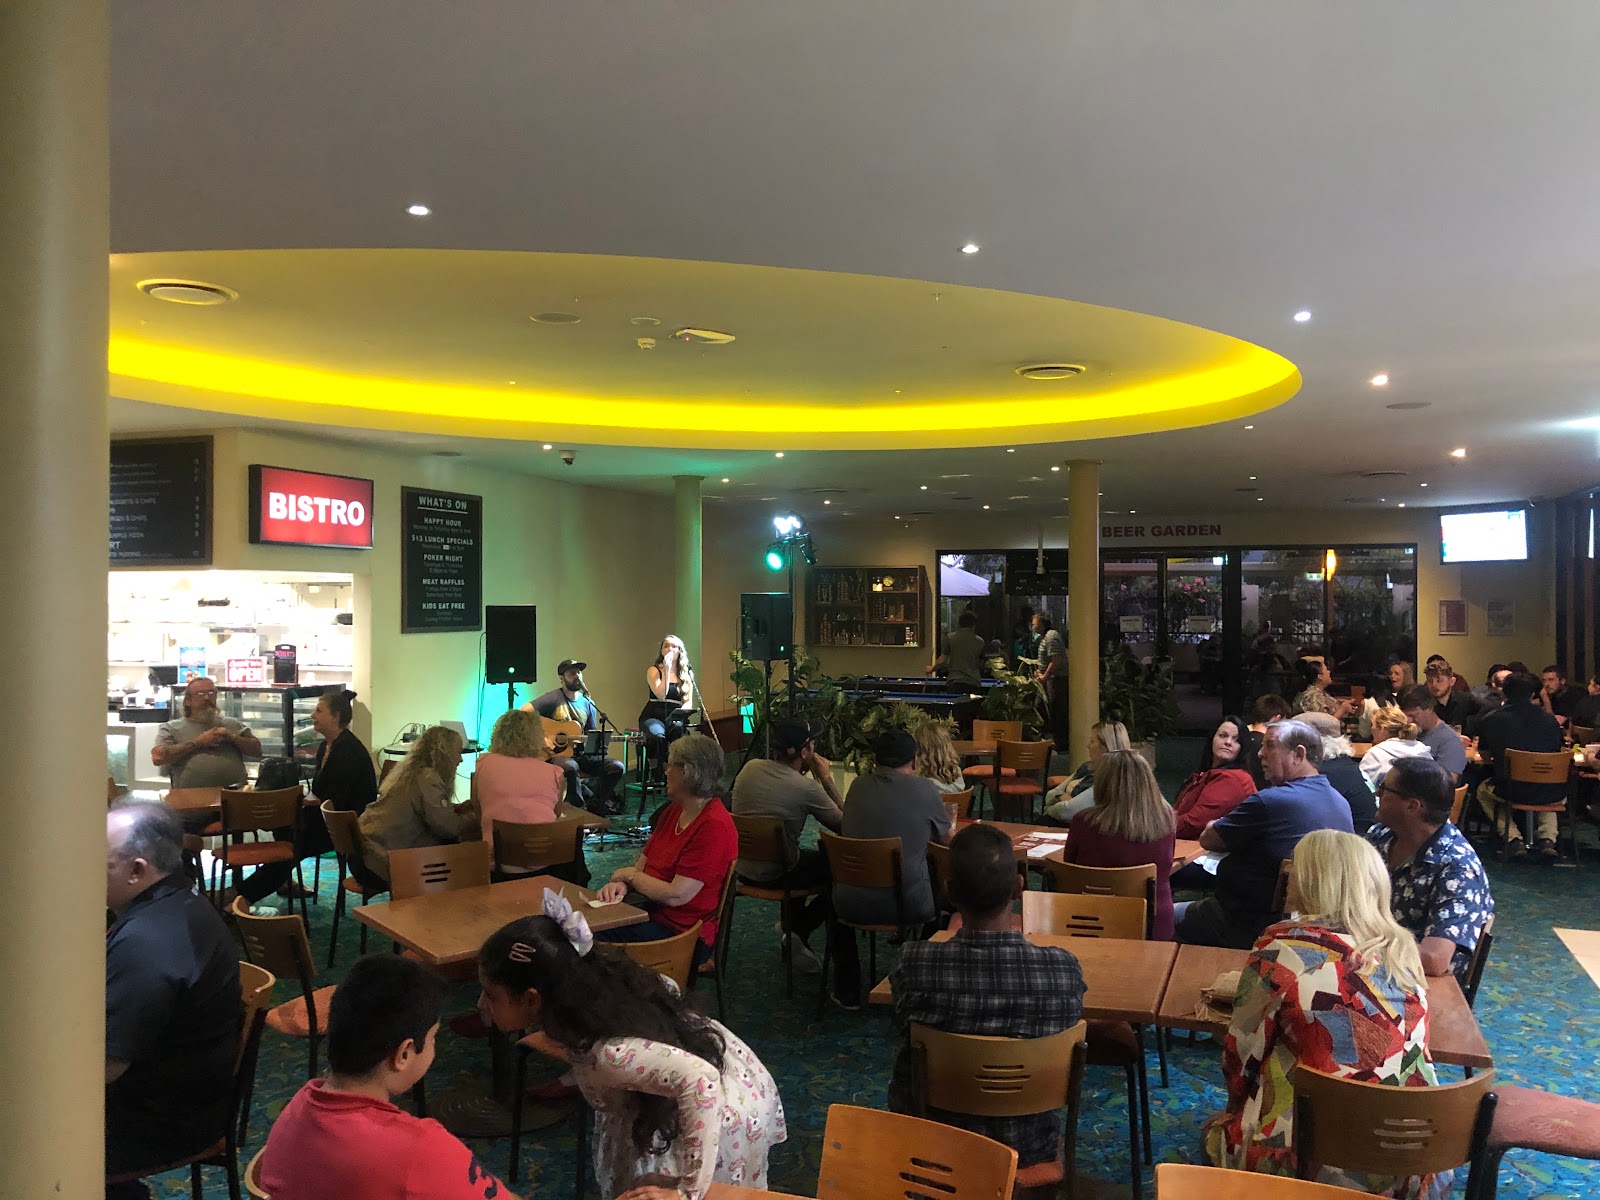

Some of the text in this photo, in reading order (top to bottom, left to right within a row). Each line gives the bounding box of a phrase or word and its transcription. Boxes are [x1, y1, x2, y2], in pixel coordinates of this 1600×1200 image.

[269, 492, 365, 527] BISTRO
[418, 496, 467, 510] WHAT'S ON
[424, 517, 462, 527] HAPPY HOUR
[1102, 524, 1221, 538] BEER GARDEN
[446, 537, 474, 545] SPECIALS
[423, 553, 444, 561] POKER
[229, 667, 261, 682] OPEN
